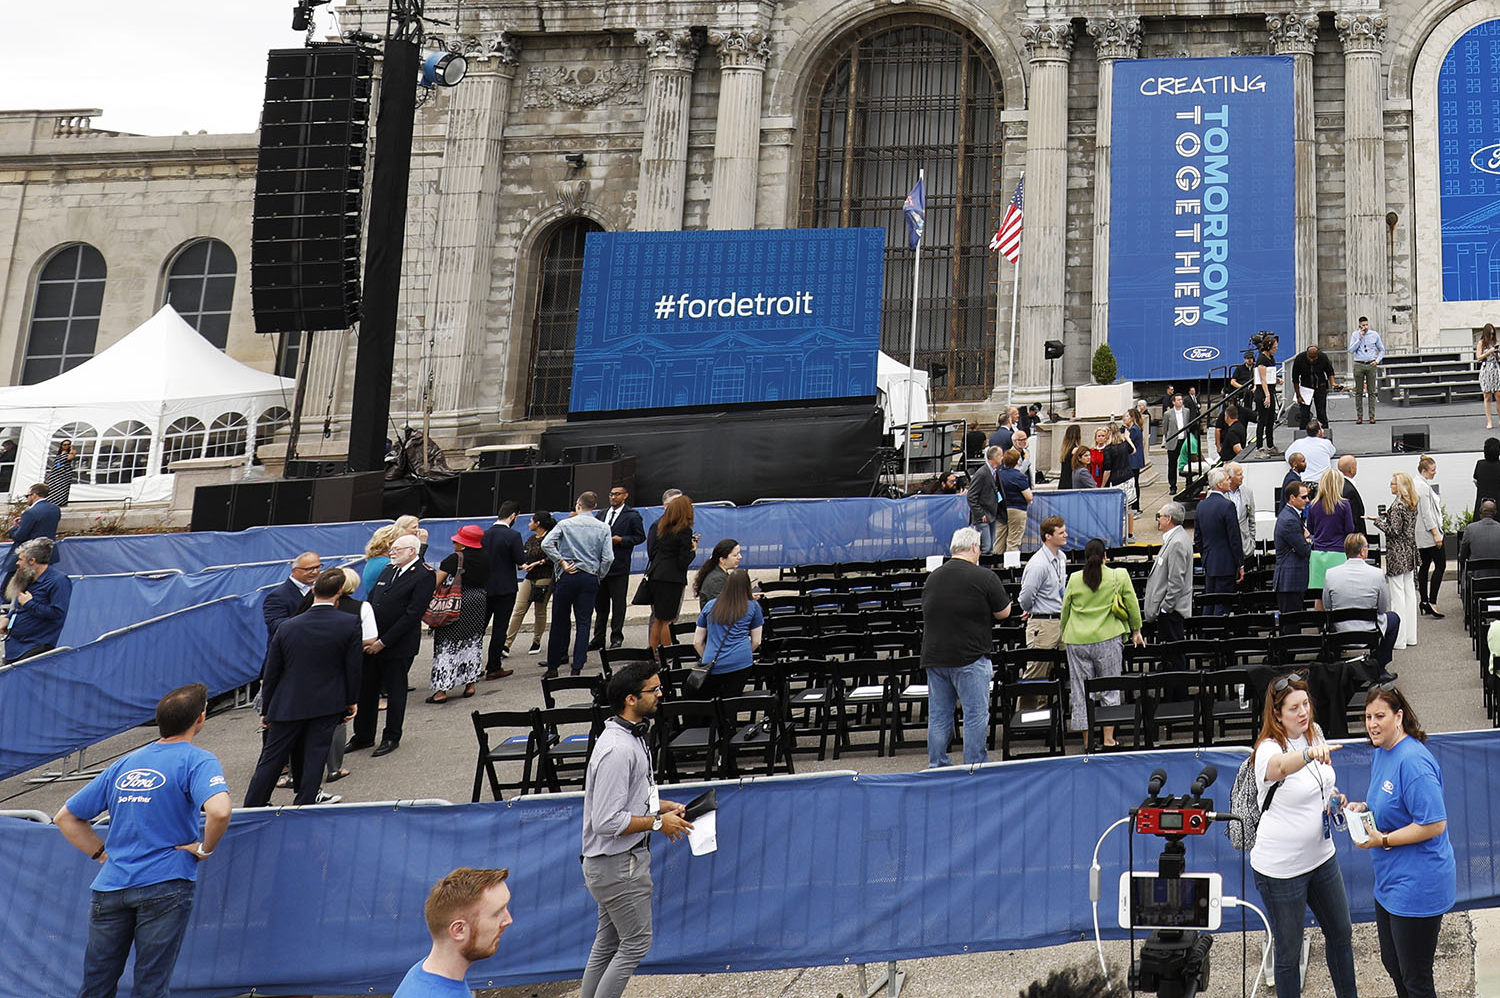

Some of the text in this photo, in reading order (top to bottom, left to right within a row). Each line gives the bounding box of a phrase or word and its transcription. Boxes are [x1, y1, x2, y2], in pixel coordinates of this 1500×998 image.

[1140, 75, 1267, 96] CREATING
[1174, 105, 1201, 327] TOGETHER
[1202, 104, 1229, 325] TOMORROW
[654, 291, 814, 319] #fordetroit
[1190, 348, 1213, 358] Ford
[121, 771, 158, 788] Ford
